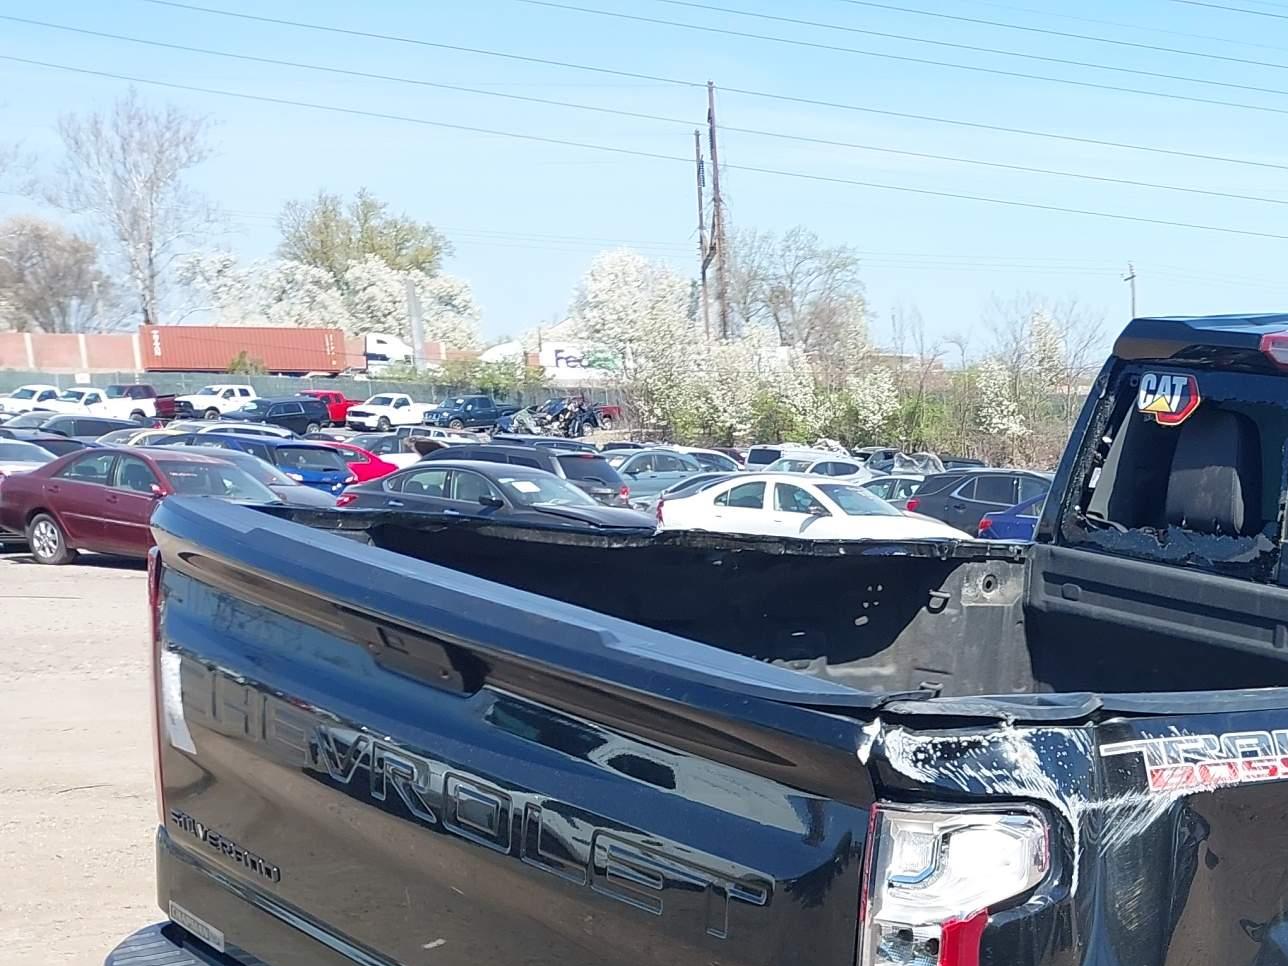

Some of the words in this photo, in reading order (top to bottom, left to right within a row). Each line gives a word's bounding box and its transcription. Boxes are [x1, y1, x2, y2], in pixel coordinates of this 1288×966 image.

[555, 349, 622, 370] Fed
[1138, 374, 1188, 412] CAT
[170, 808, 281, 883] SILVERADO
